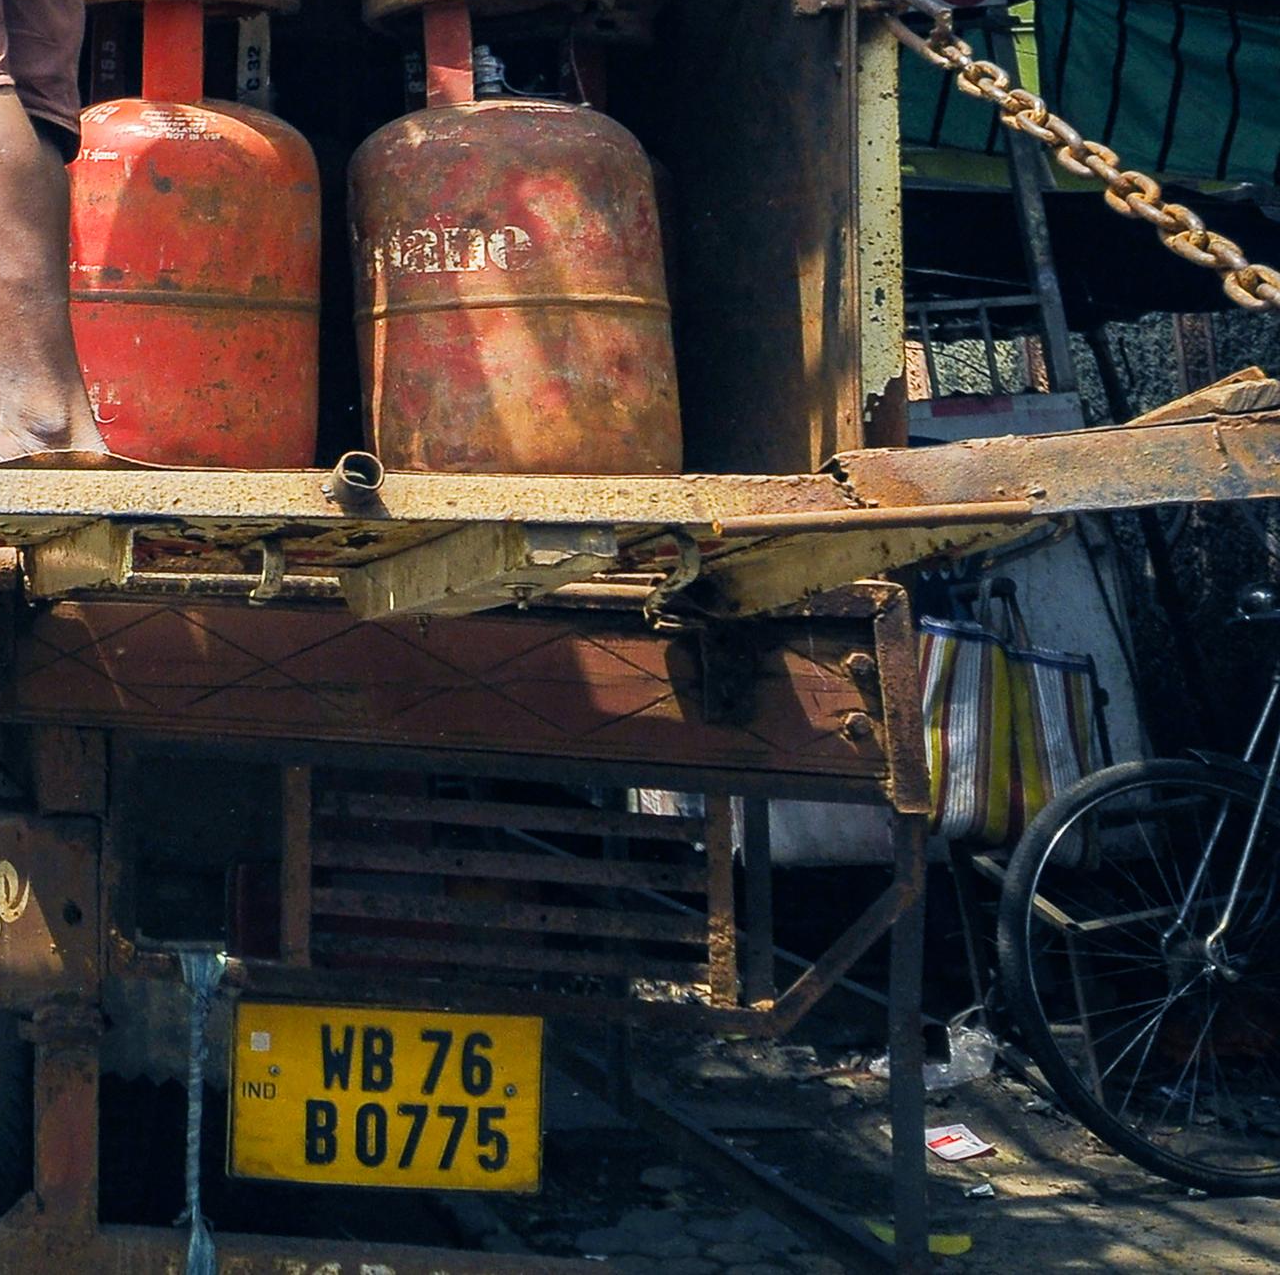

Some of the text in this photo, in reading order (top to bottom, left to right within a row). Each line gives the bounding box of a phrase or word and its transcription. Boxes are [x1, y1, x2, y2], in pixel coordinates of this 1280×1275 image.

[320, 1024, 494, 1097] WB 76
[242, 1081, 276, 1101] IND
